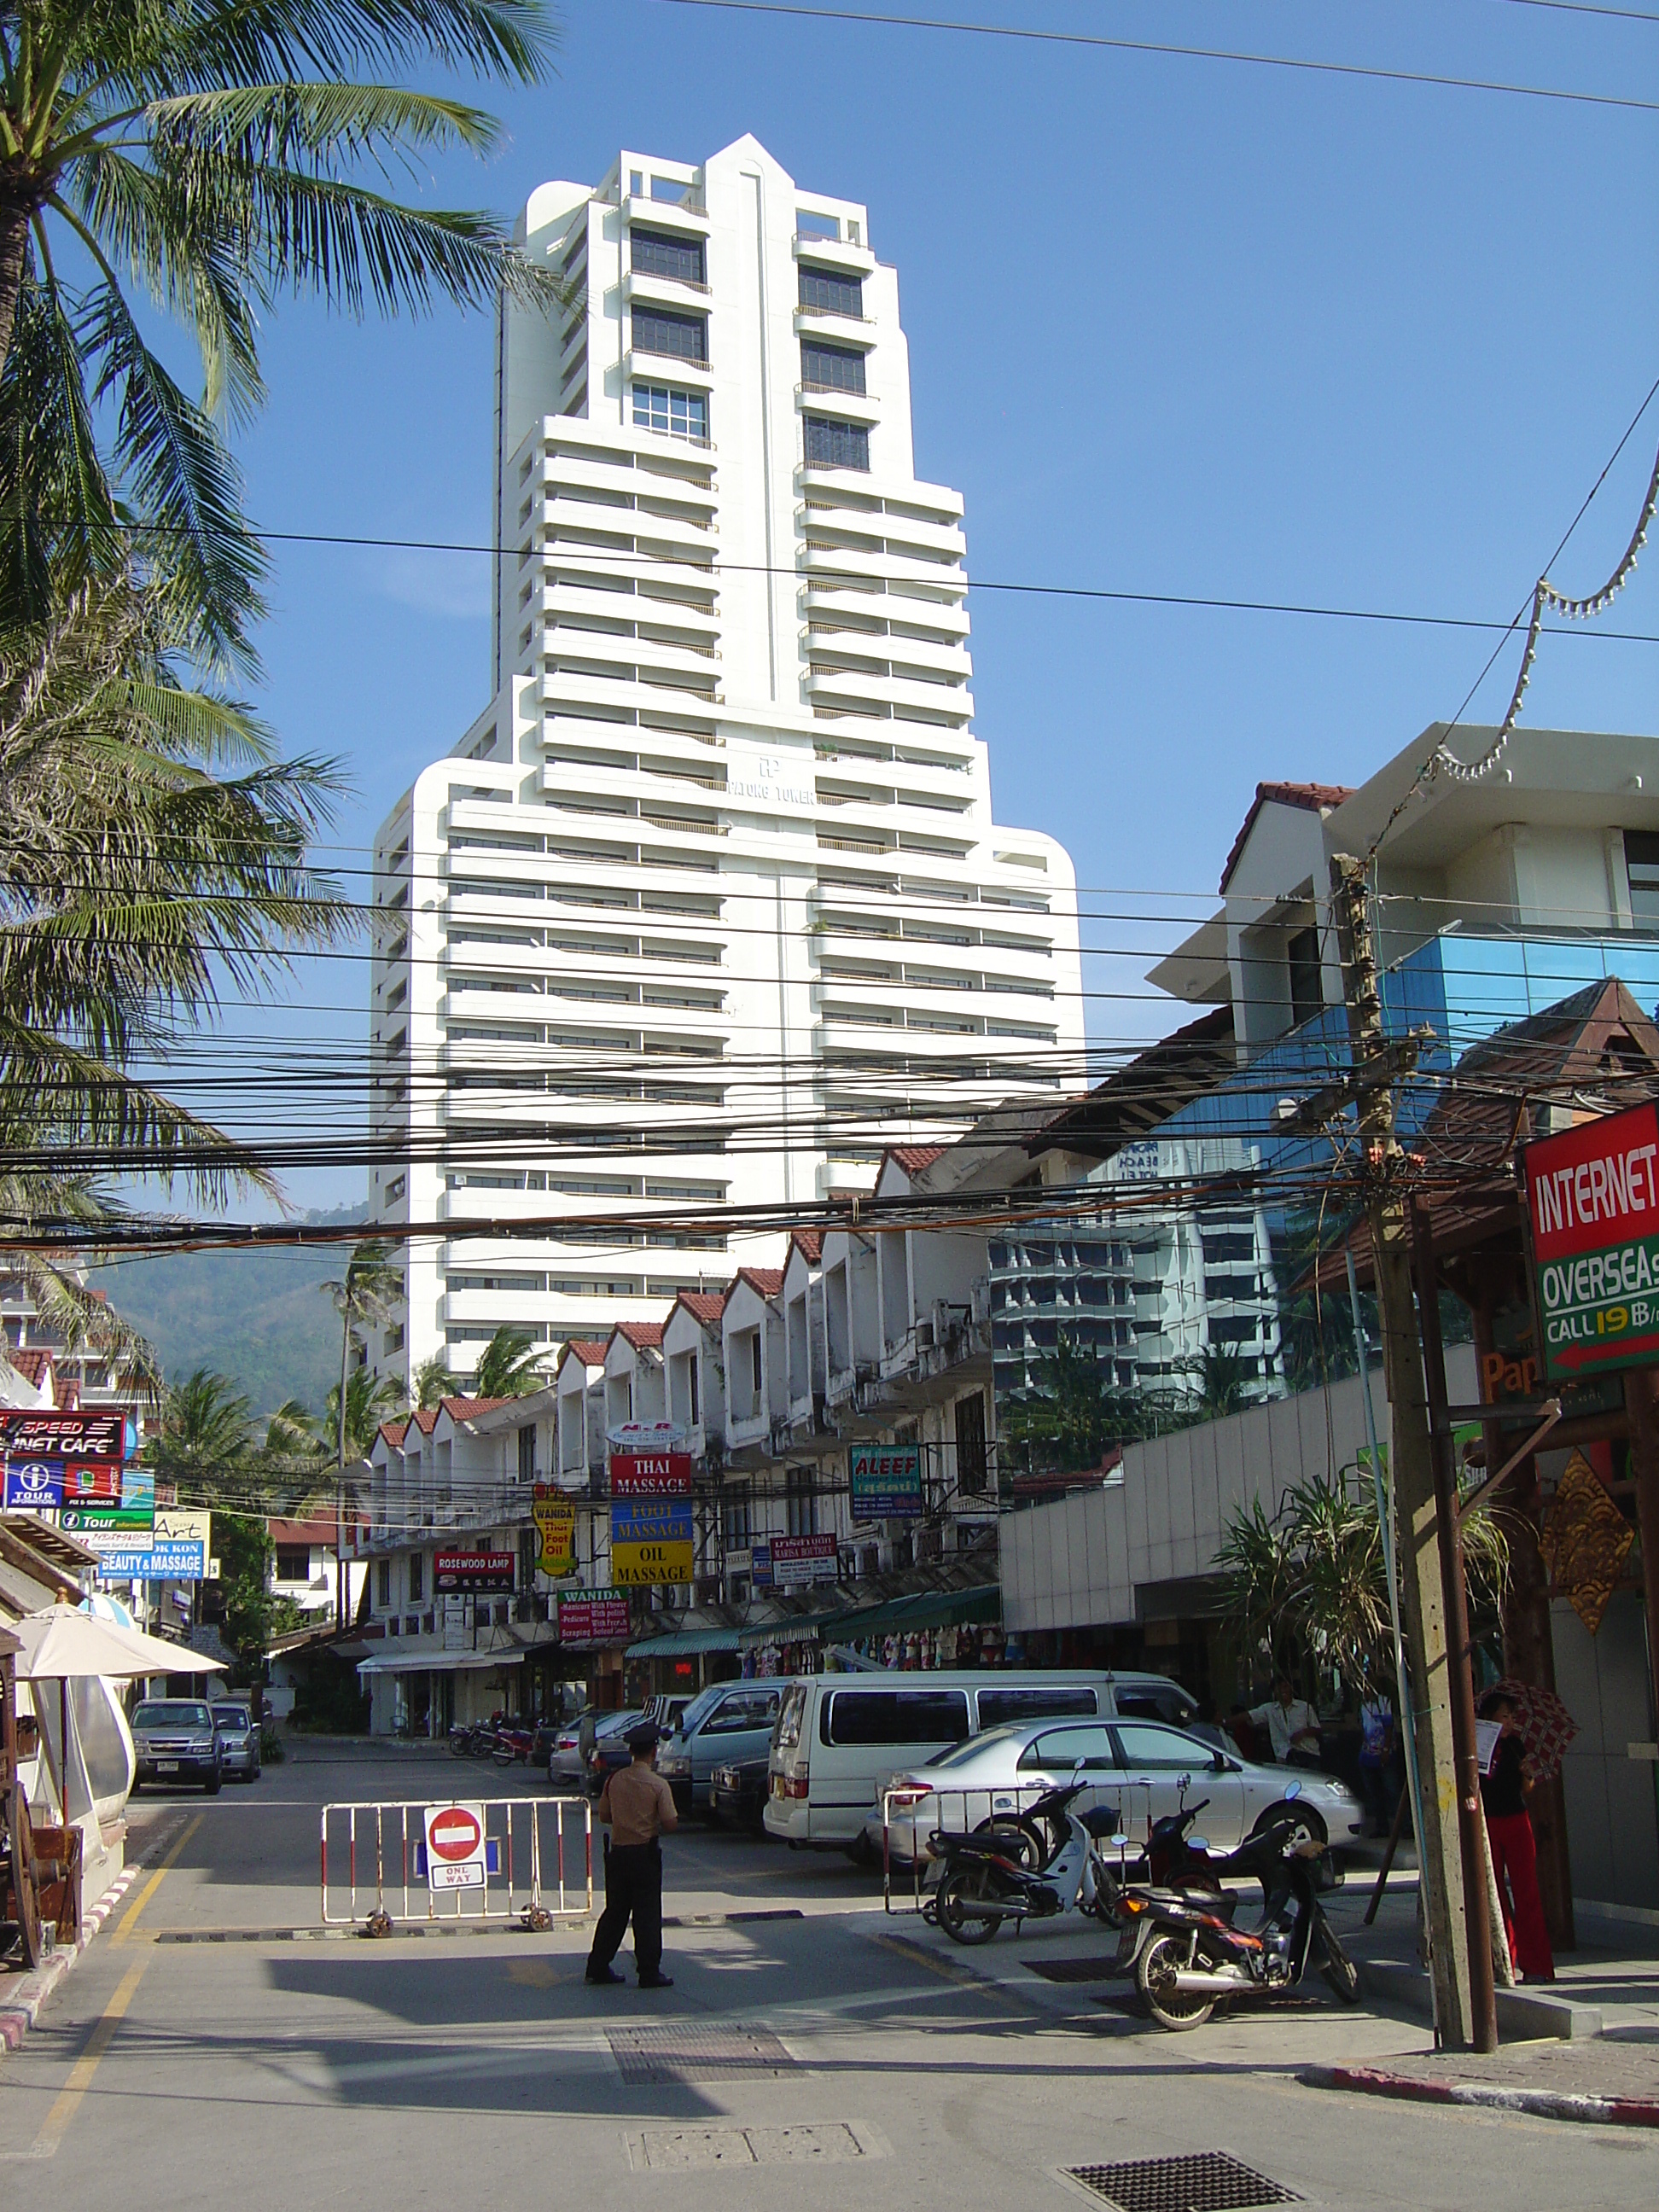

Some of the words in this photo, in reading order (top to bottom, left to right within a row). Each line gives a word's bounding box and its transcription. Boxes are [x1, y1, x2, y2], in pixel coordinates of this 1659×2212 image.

[727, 781, 769, 800] PATONG
[775, 786, 815, 806] TOWER
[1535, 1144, 1657, 1234] INTERNET
[1547, 1314, 1595, 1343] CALL
[1597, 1306, 1629, 1335] 19
[21, 1421, 84, 1435] SPEED
[633, 1459, 671, 1475] THAI
[855, 1457, 917, 1476] ALEEF
[617, 1477, 687, 1493] MASSAGE
[15, 1491, 53, 1499] TOUR
[632, 1504, 672, 1518] FOOT
[83, 1516, 115, 1528] Tour
[154, 1517, 201, 1539] Art
[544, 1522, 568, 1532] Thai
[618, 1522, 688, 1539] MASSAGE
[545, 1534, 569, 1543] Foot
[172, 1544, 199, 1553] KON
[545, 1545, 563, 1555] Oil
[639, 1546, 667, 1562] OIL
[775, 1546, 800, 1557] MARISA
[800, 1545, 834, 1557] BOUTIQUE
[102, 1554, 143, 1571] BEAUTY
[143, 1559, 150, 1570] &
[150, 1555, 201, 1572] MASSAGE
[439, 1557, 486, 1569] ROSEWOOD
[487, 1558, 509, 1569] LAMP
[617, 1565, 688, 1582] MASSAGE
[564, 1589, 623, 1603] WANIDA
[562, 1628, 591, 1638] Scraping
[446, 1874, 471, 1884] WAY
